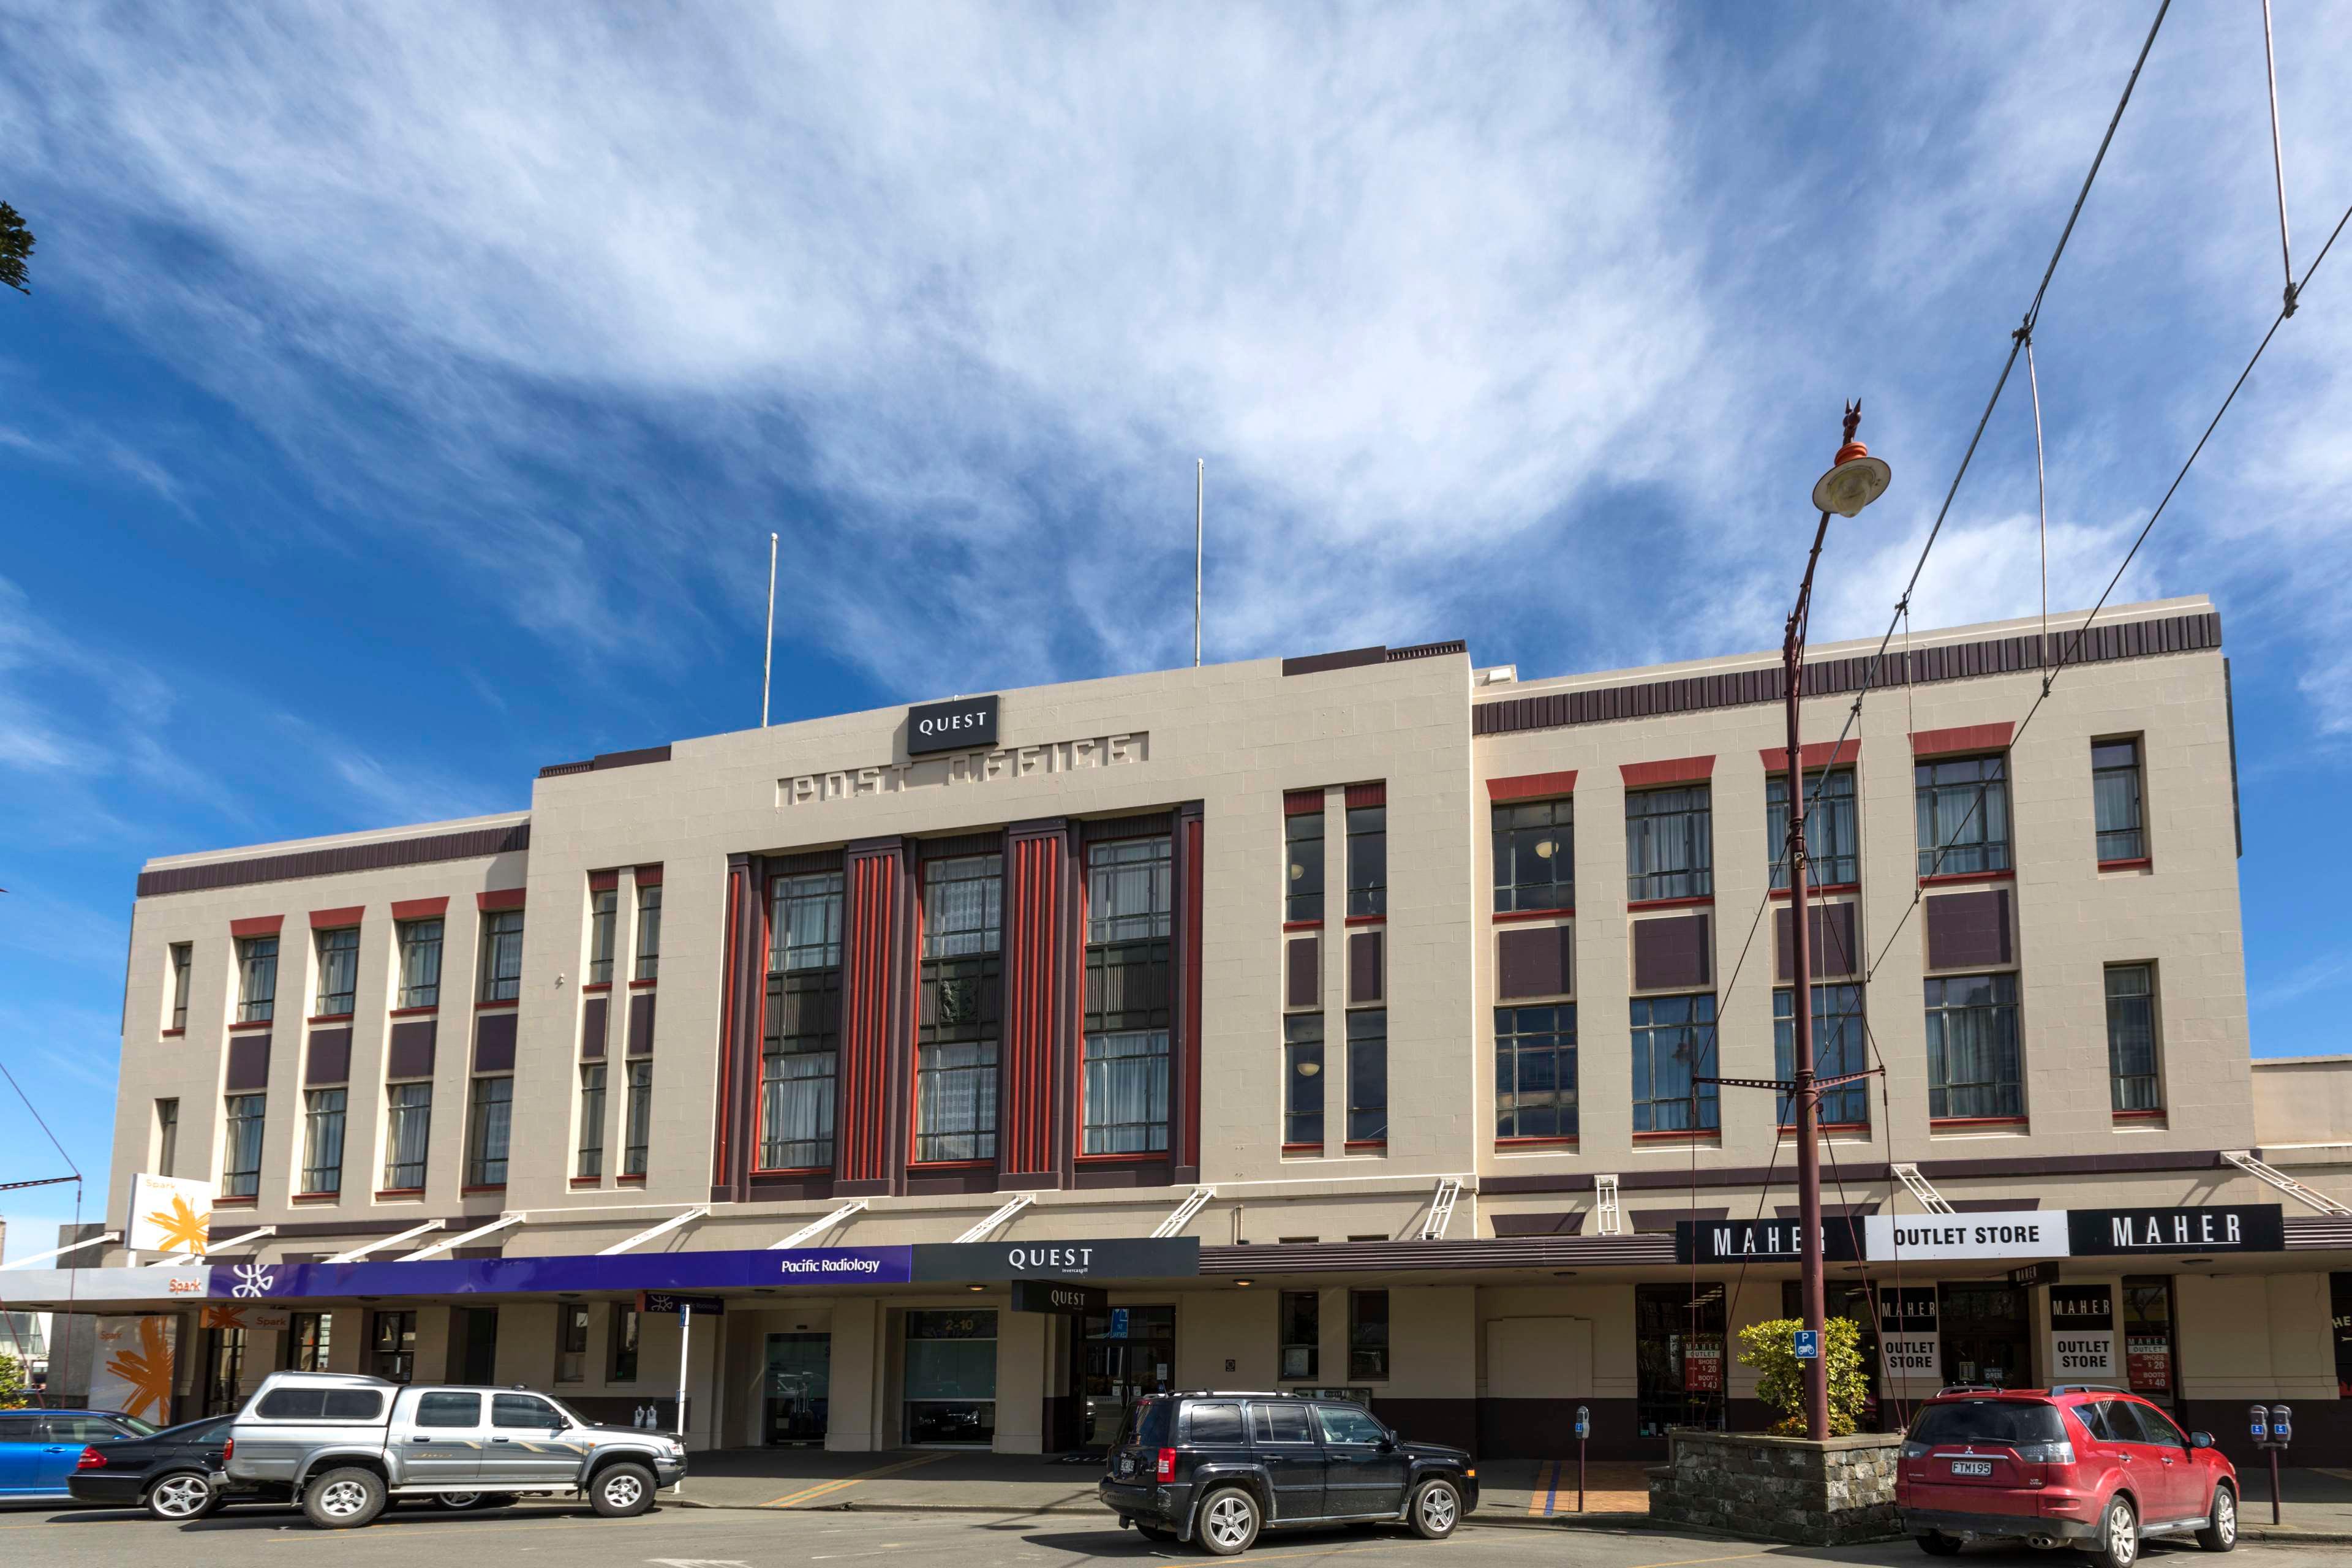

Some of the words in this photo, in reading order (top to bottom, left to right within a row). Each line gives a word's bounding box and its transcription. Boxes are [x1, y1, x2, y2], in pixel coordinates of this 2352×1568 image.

[919, 712, 986, 735] QUEST
[793, 763, 912, 804] POST
[949, 734, 1131, 785] OFFICE
[146, 1179, 175, 1190] Spark
[1894, 1227, 1966, 1246] OUTLET
[1975, 1226, 2040, 1244] STORE
[2112, 1214, 2240, 1246] MAHER
[782, 1259, 820, 1273] Pacific
[821, 1258, 880, 1273] Radiology
[1008, 1249, 1093, 1270] QUEST
[169, 1277, 202, 1294] Spark
[1051, 1289, 1085, 1306] QUEST
[1882, 1302, 1936, 1317] MAHER
[2052, 1299, 2109, 1315] MAHER
[256, 1316, 286, 1327] Spark
[1801, 1332, 1809, 1343] P
[1886, 1341, 1935, 1354] OUTLET
[2058, 1341, 2109, 1353] OUTLET
[1890, 1356, 1932, 1368] STORE
[2062, 1355, 2108, 1367] STORE
[1953, 1463, 1990, 1473] FTM195
